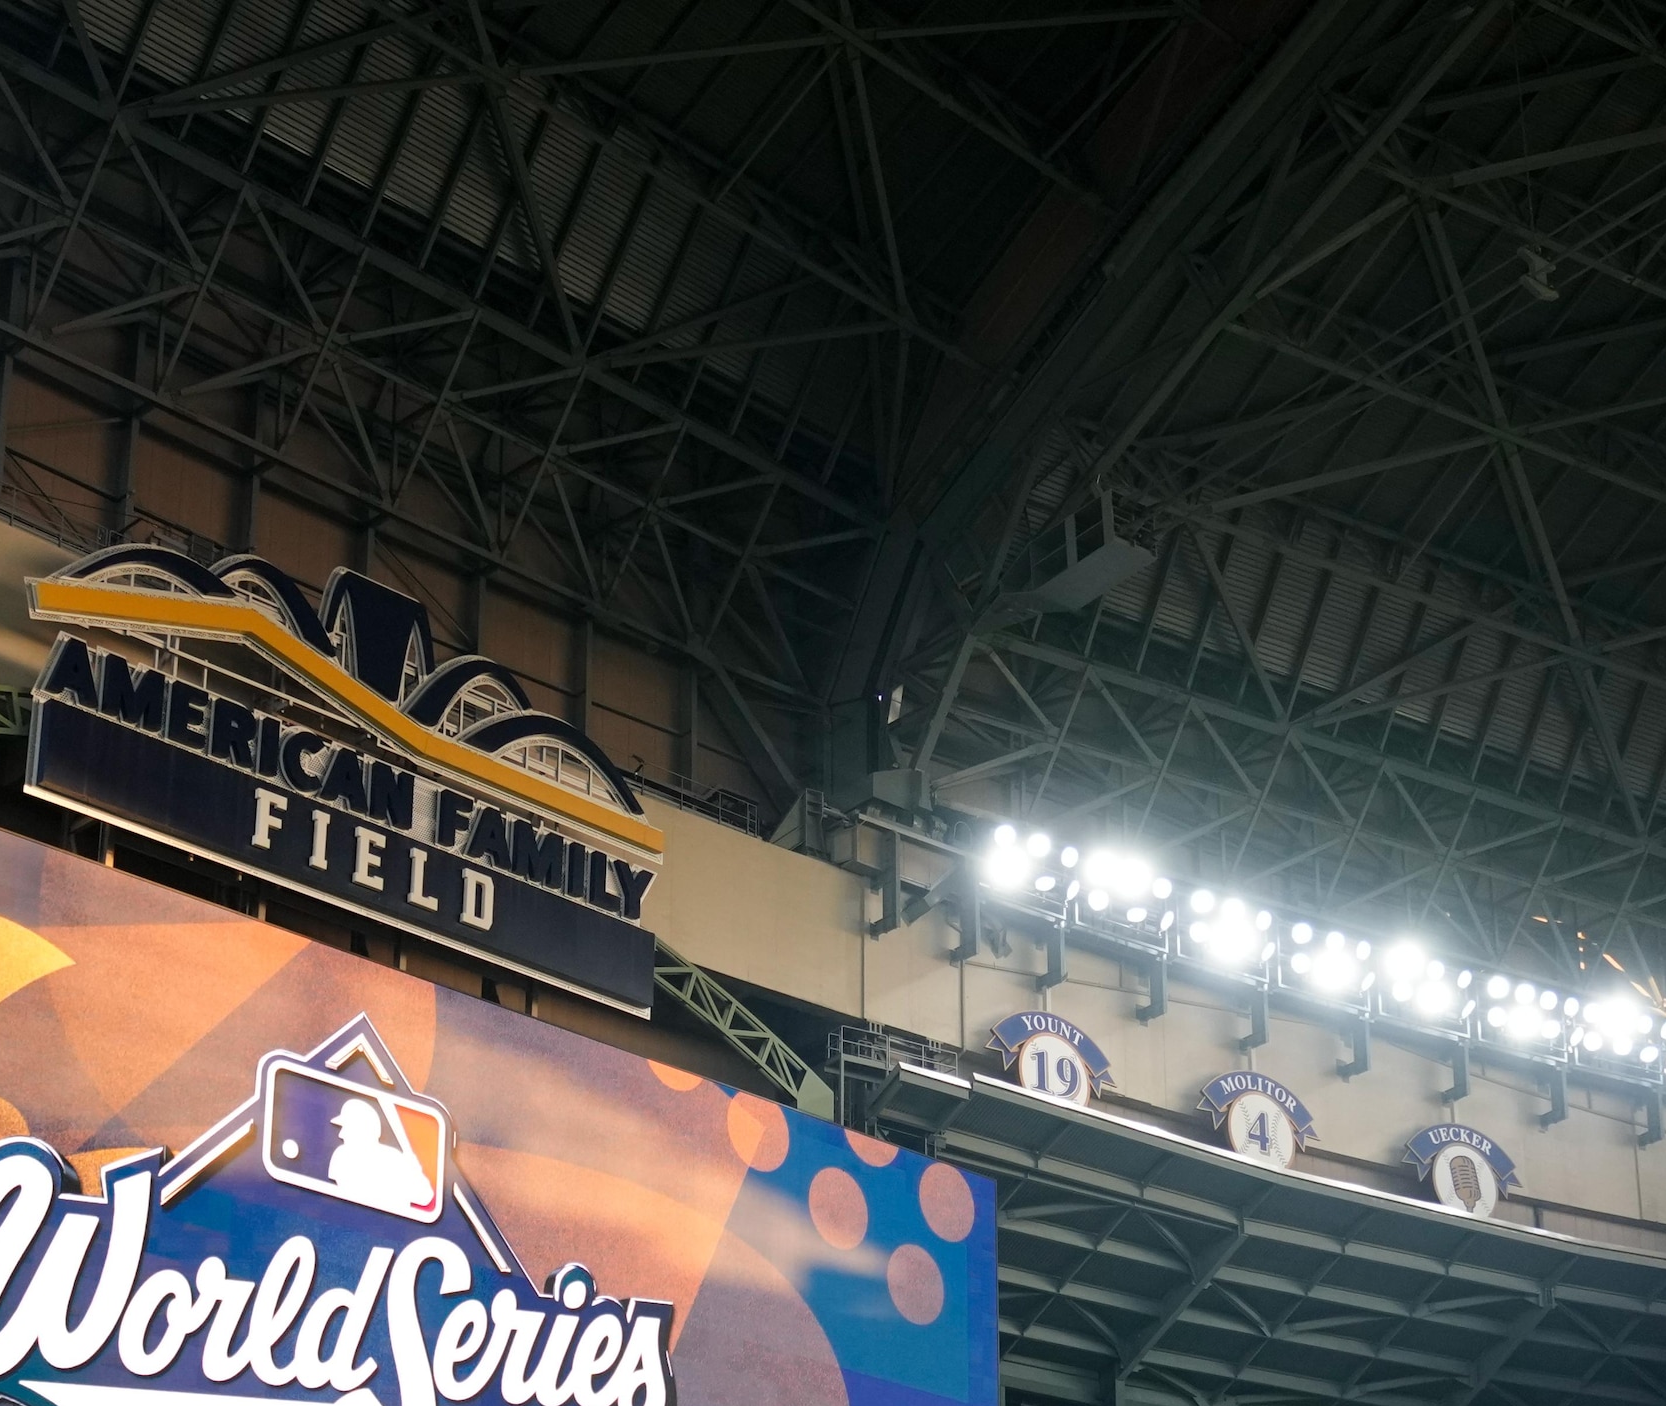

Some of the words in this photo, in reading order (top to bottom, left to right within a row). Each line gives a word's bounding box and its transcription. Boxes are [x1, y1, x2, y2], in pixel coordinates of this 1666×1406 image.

[35, 630, 421, 832] AMERICAN
[435, 786, 656, 922] FAMILY
[251, 787, 495, 931] FIELD
[1020, 1014, 1084, 1046] YOUNT
[1031, 1049, 1081, 1098] 19
[1220, 1076, 1298, 1113] MOLITOR
[1247, 1111, 1271, 1156] 4
[1428, 1127, 1493, 1157] UECKER
